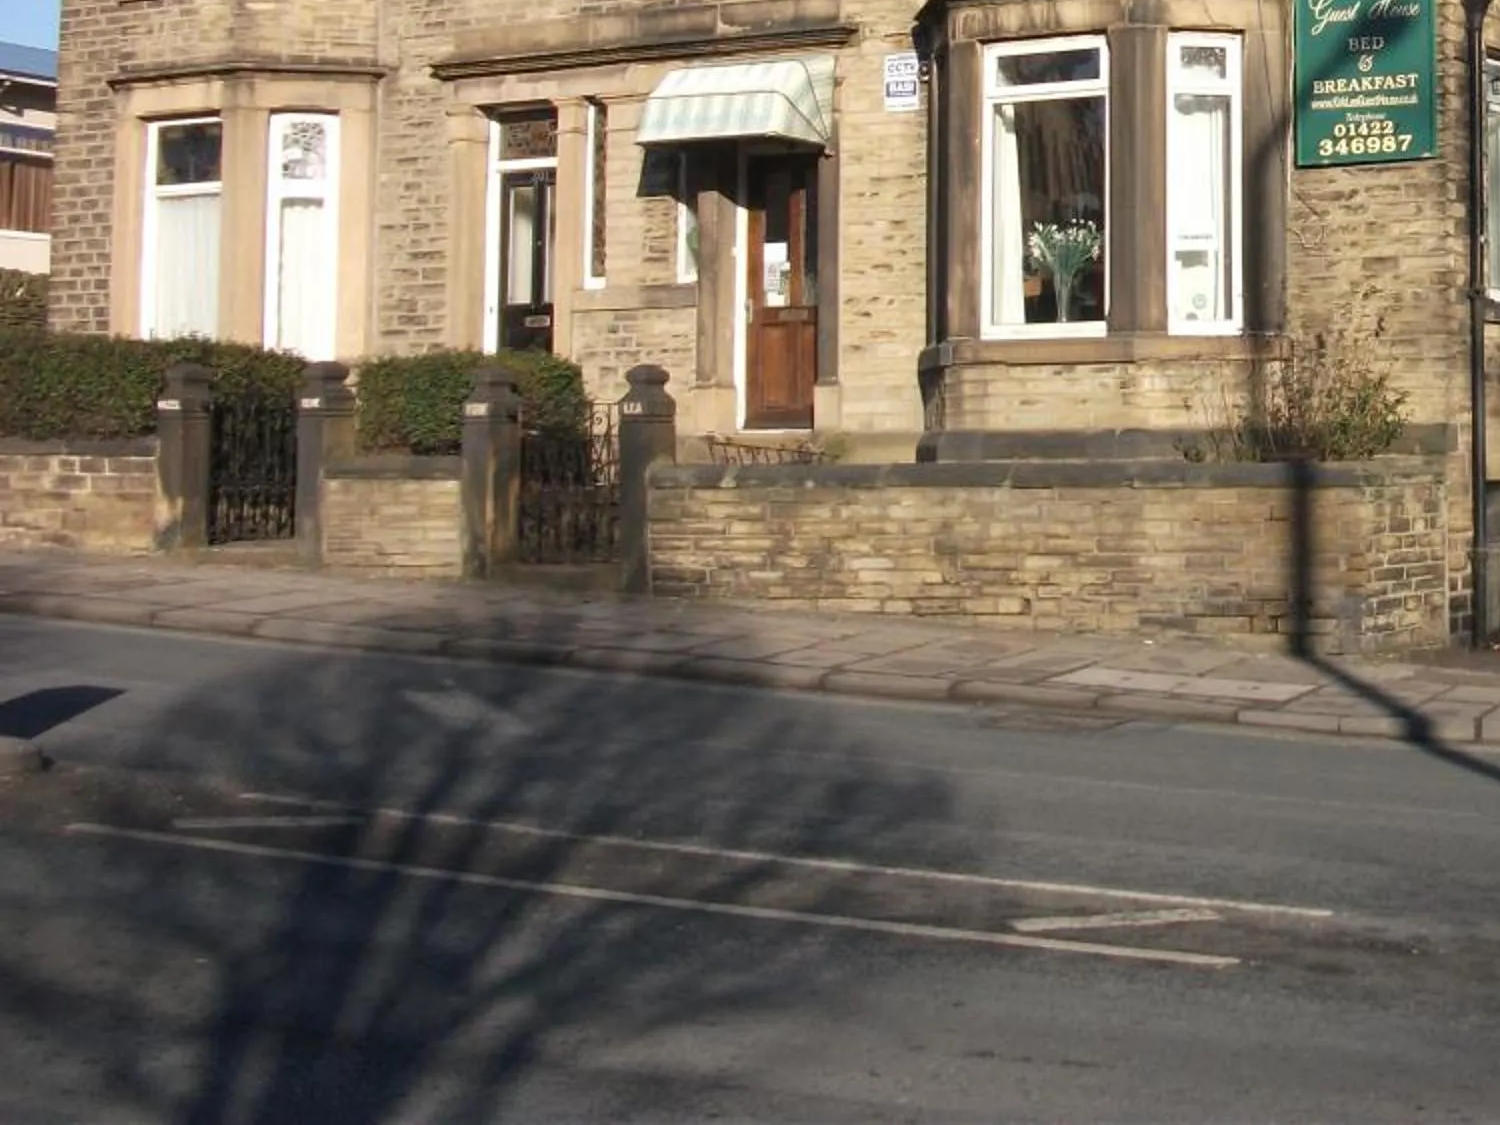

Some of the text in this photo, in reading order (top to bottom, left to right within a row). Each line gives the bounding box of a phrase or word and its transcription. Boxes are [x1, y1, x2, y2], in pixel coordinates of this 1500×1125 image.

[1348, 36, 1384, 51] BED
[1358, 54, 1374, 72] &
[1313, 73, 1419, 94] BREAKFAST
[1334, 120, 1395, 137] 01422
[1318, 134, 1412, 156] 346987
